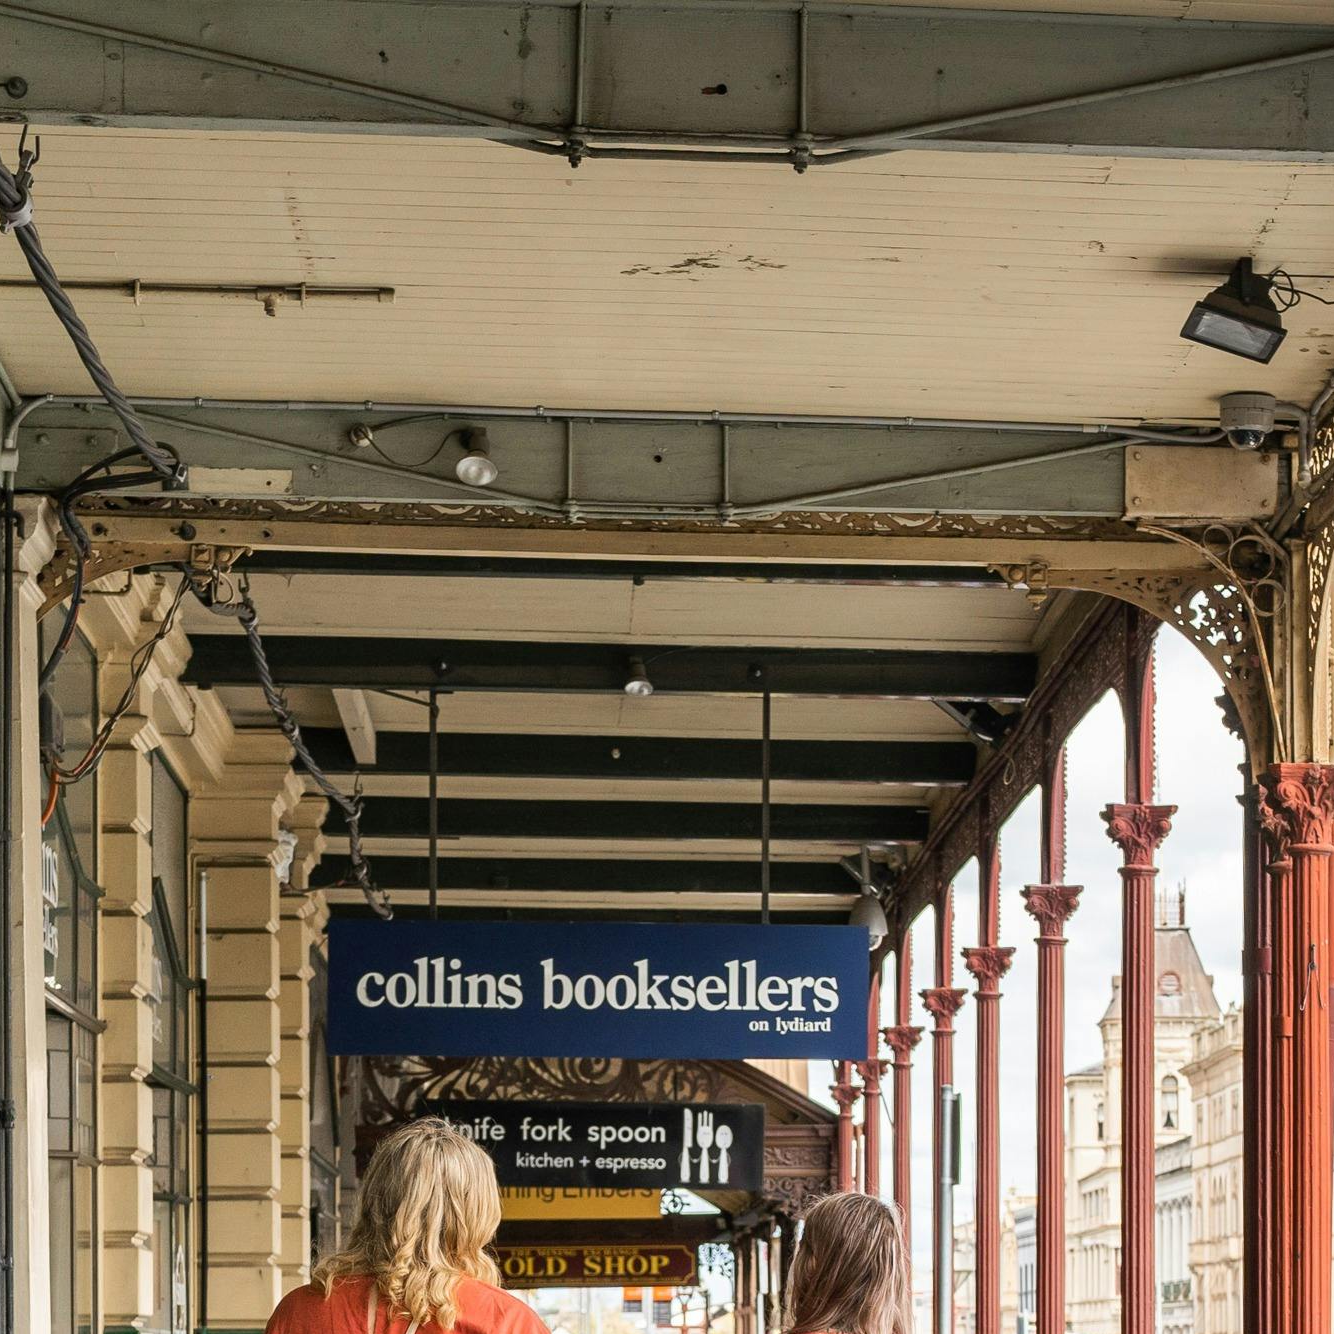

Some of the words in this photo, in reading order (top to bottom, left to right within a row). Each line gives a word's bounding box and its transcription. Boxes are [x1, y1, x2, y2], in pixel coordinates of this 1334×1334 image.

[355, 956, 524, 1010] collins
[540, 957, 840, 1013] booksellers
[748, 1020, 769, 1033] on
[775, 1017, 832, 1036] lydiard
[520, 1117, 573, 1142] fork
[587, 1124, 667, 1150] spoon
[516, 1152, 574, 1169] kitchen
[595, 1156, 667, 1174] espresso
[583, 1254, 671, 1277] SHOP
